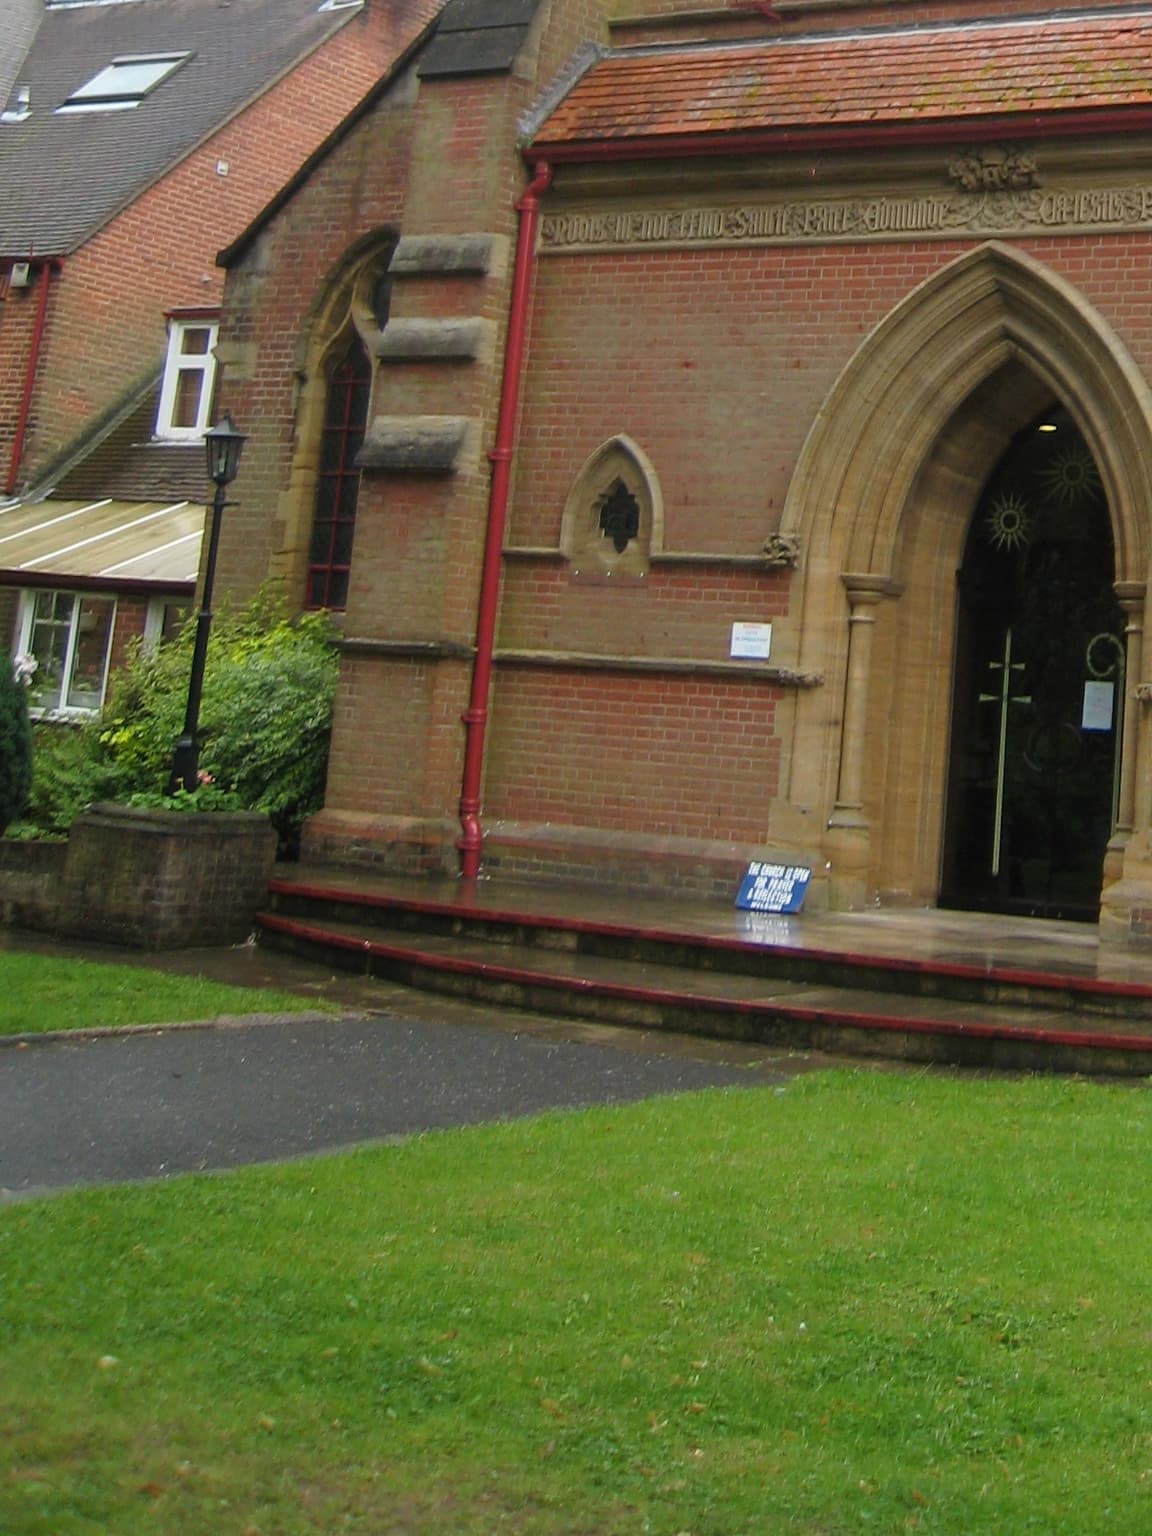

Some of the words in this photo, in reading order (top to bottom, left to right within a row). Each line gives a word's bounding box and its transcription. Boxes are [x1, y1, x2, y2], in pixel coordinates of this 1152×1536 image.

[760, 863, 786, 878] CHURCH
[793, 867, 811, 882] OPEN
[768, 878, 795, 892] PRAYER
